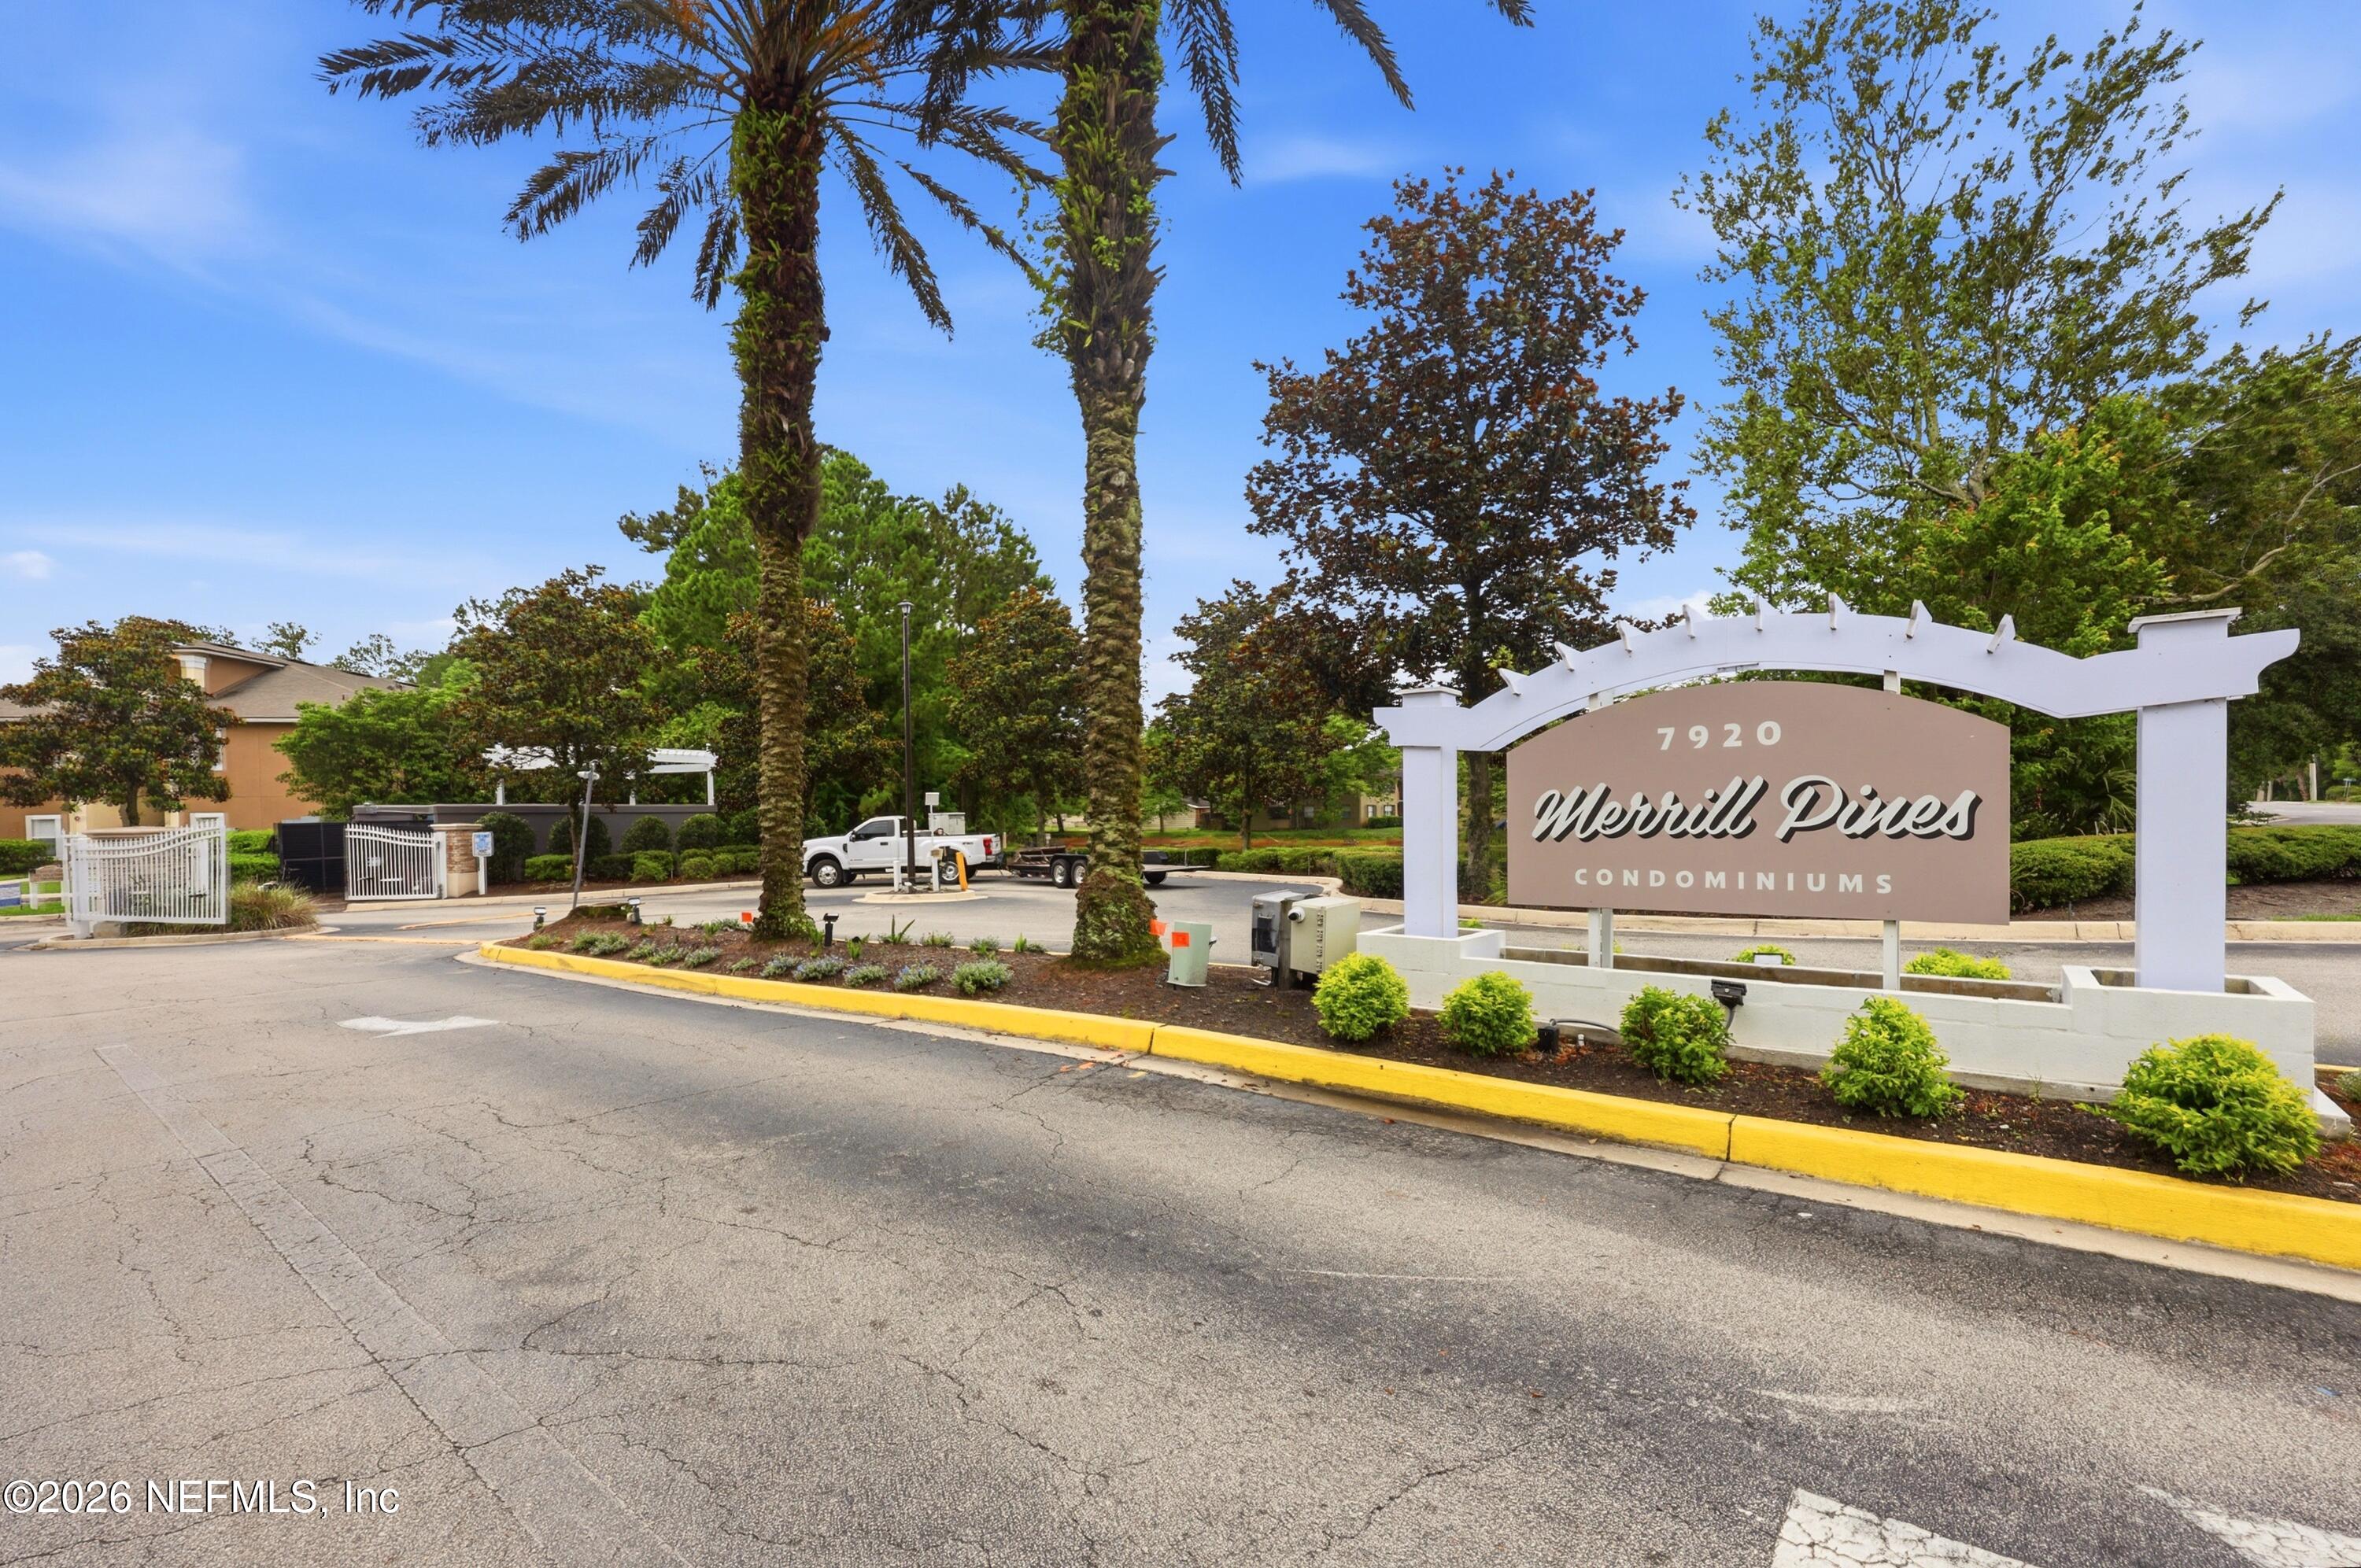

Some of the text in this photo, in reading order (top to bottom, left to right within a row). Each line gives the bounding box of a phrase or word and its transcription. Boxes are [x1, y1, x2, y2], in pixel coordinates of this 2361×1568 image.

[1657, 721, 1782, 751] 7920
[1532, 775, 1983, 844] Merrill Pines
[1575, 869, 1893, 895] CONDOMINIUMS
